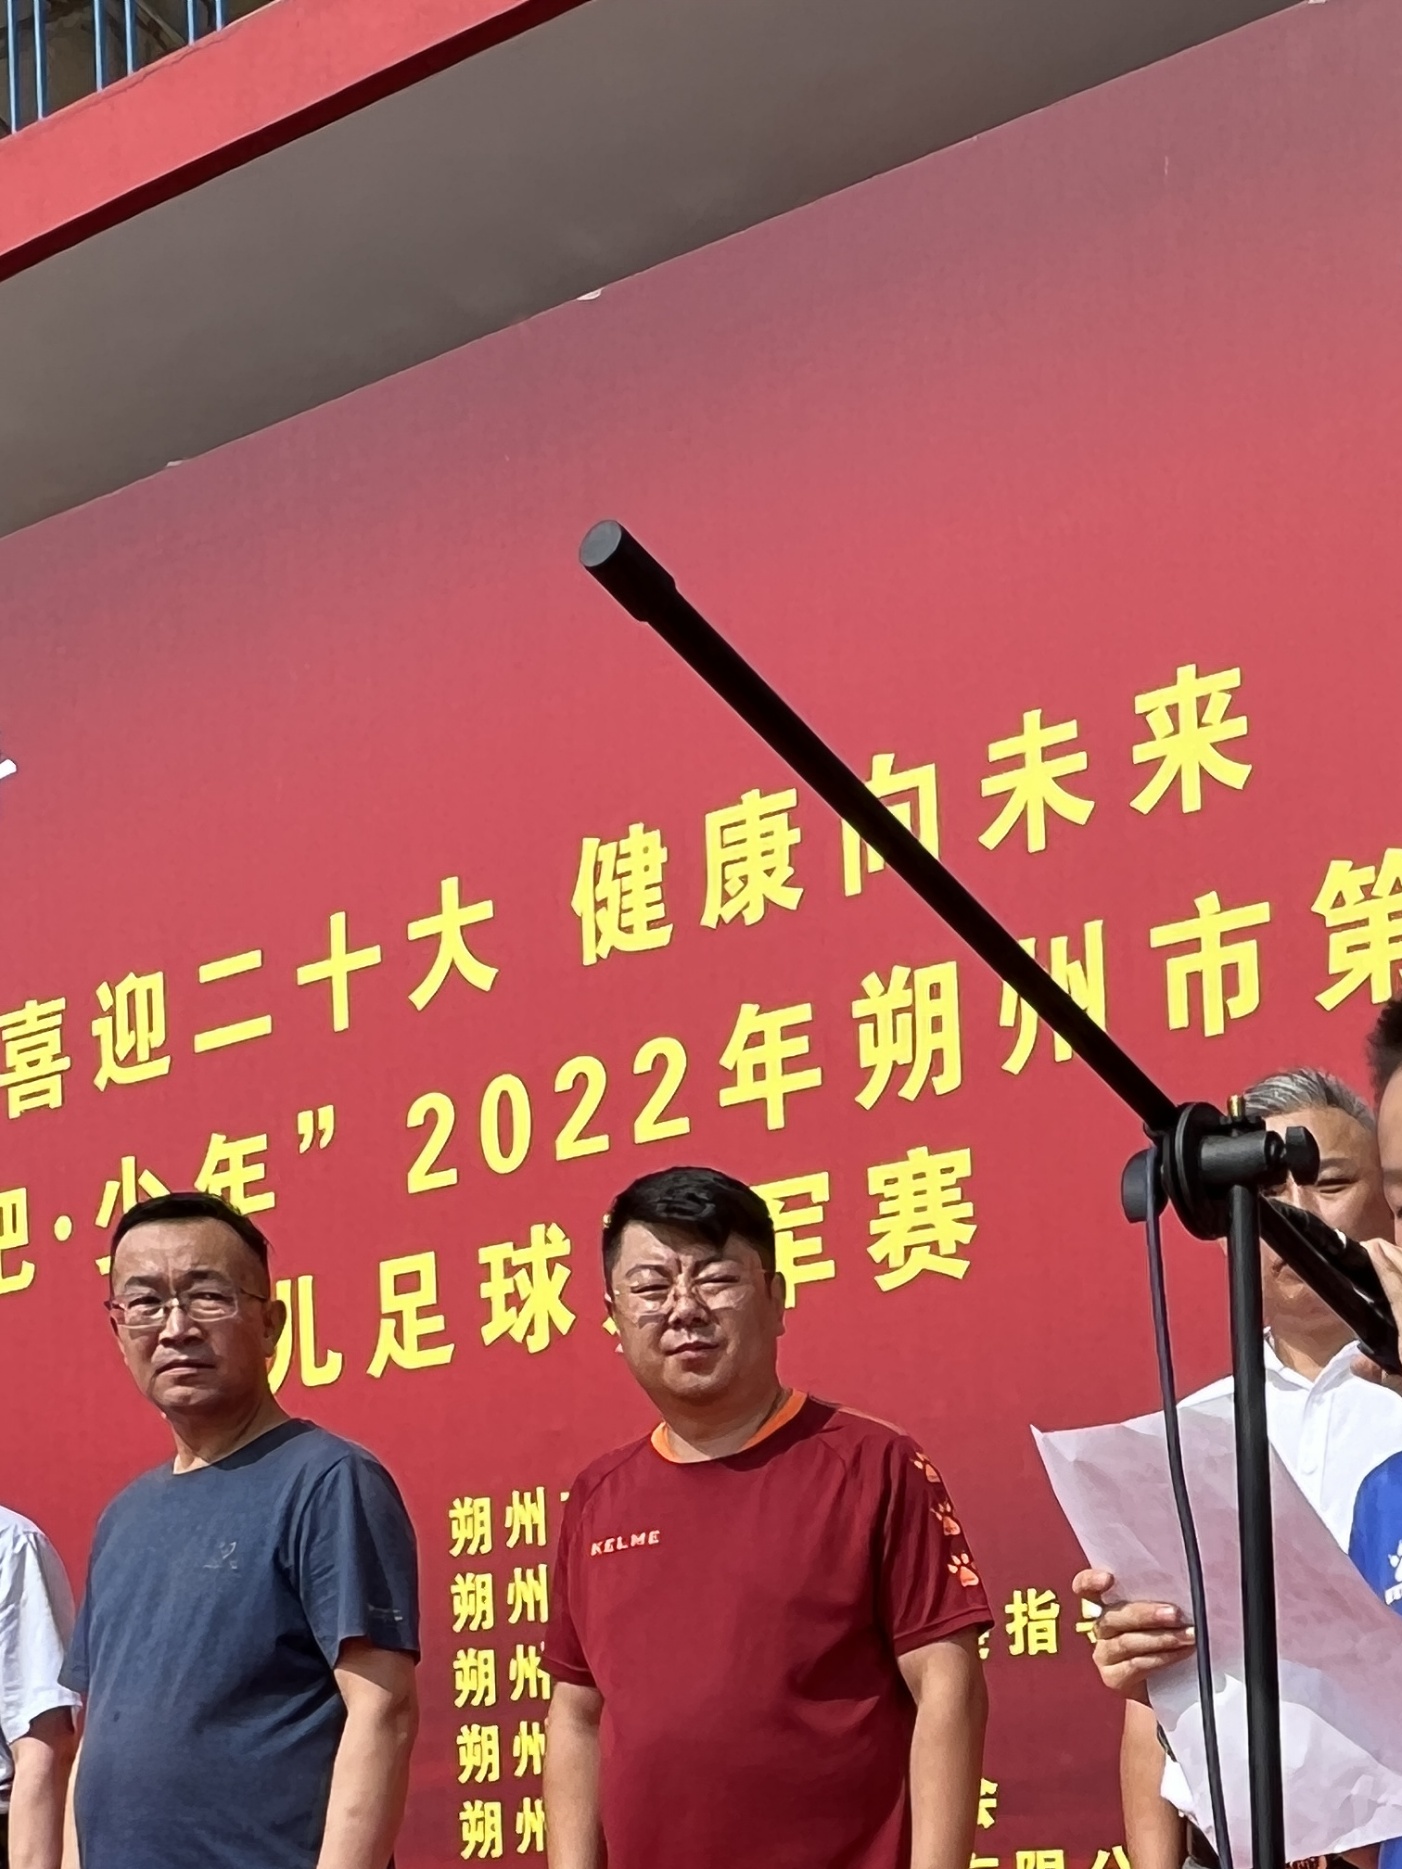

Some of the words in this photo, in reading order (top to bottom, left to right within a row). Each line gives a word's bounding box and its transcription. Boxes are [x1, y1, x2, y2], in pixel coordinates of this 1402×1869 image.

[0, 877, 499, 1119] 喜迎二十大
[571, 663, 1253, 967] 健康向未来
[448, 1486, 570, 1557] 朔州
[590, 1529, 660, 1557] KELME
